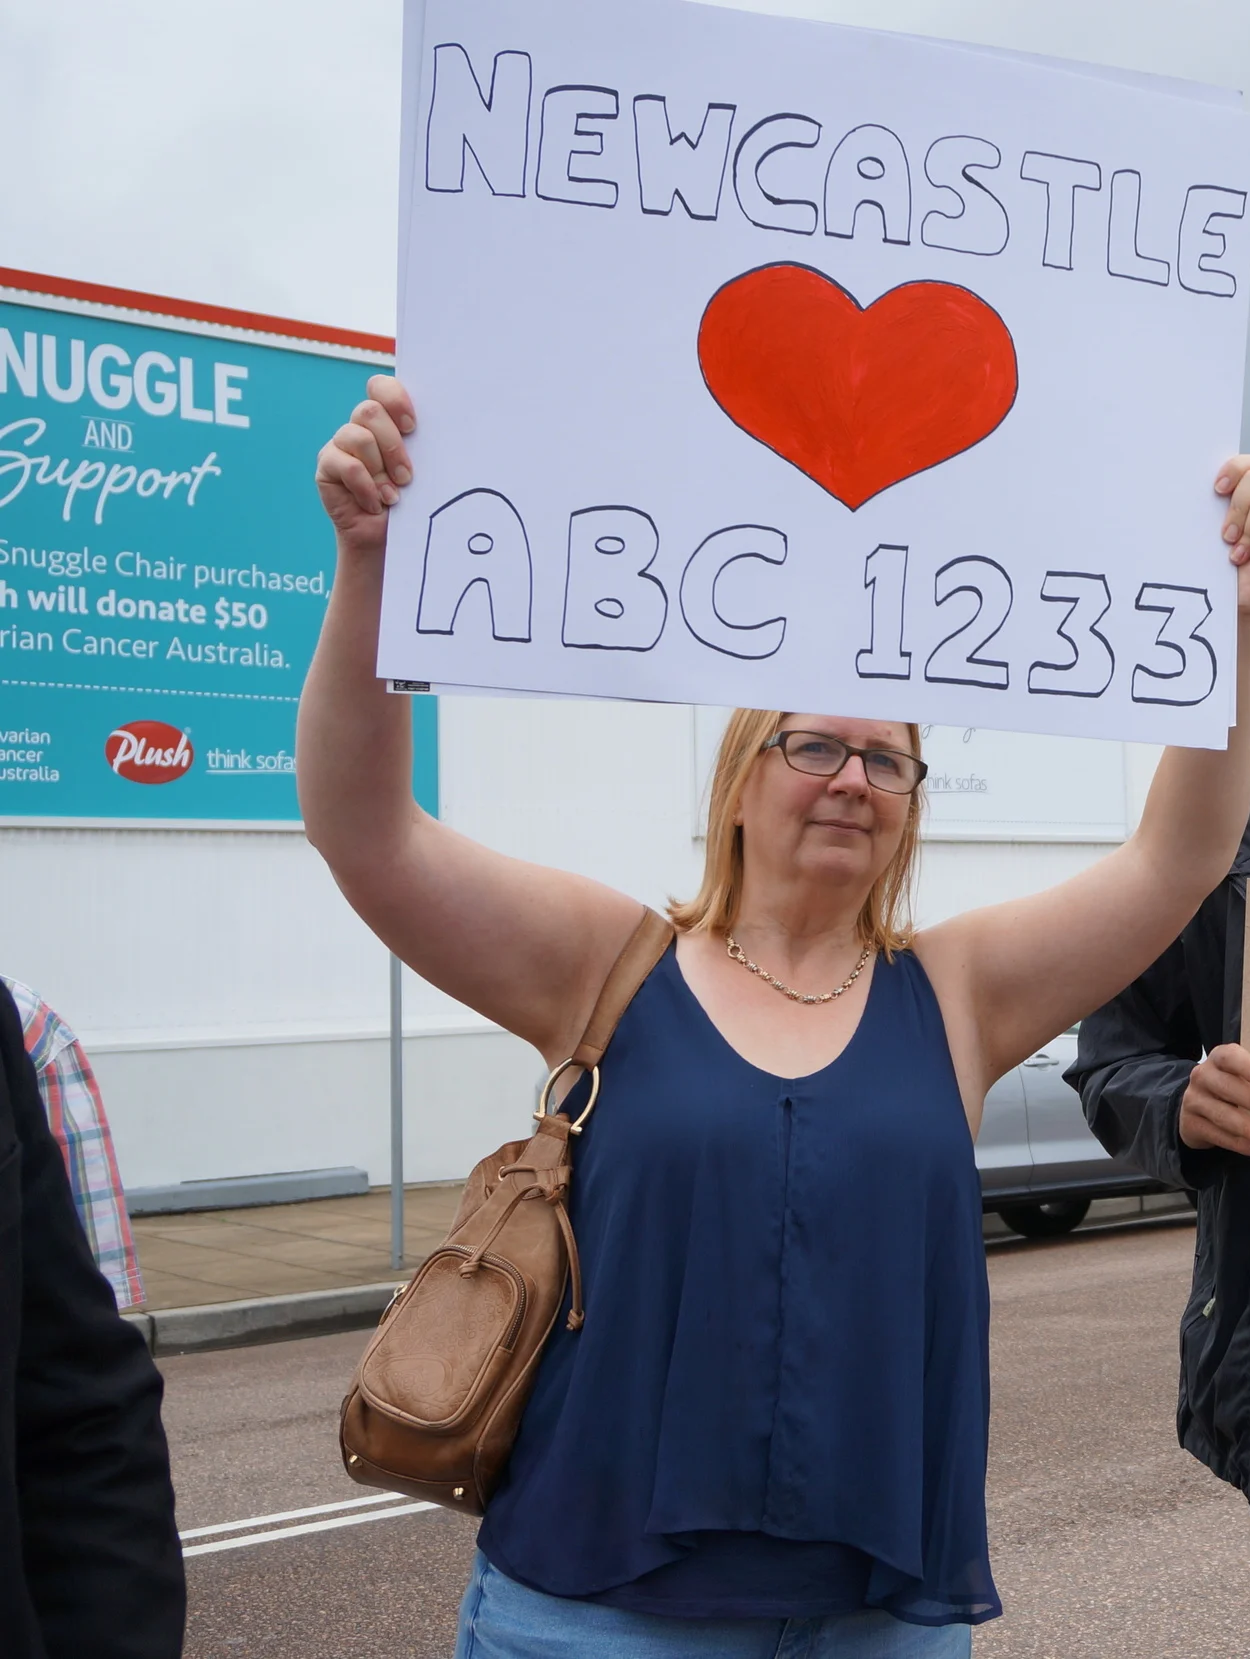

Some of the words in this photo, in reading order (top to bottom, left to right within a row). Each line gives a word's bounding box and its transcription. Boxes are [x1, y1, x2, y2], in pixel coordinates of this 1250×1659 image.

[426, 43, 1248, 298] NEWCASTLE
[0, 327, 250, 429] NUGGLE
[84, 420, 133, 450] AND
[0, 417, 222, 525] Support
[115, 551, 187, 580] Chair
[195, 564, 330, 599] purchased,
[416, 488, 788, 660] ABC
[856, 544, 1218, 707] 1233
[27, 585, 89, 614] will
[96, 589, 206, 624] donate
[214, 597, 268, 630] $50
[0, 624, 53, 651] rian
[62, 628, 159, 658] Cancer
[166, 636, 290, 669] Australia.
[109, 729, 191, 775] Plush
[207, 747, 251, 769] think
[256, 751, 297, 771] sofa
[927, 772, 951, 790] hink
[956, 773, 988, 791] sofas
